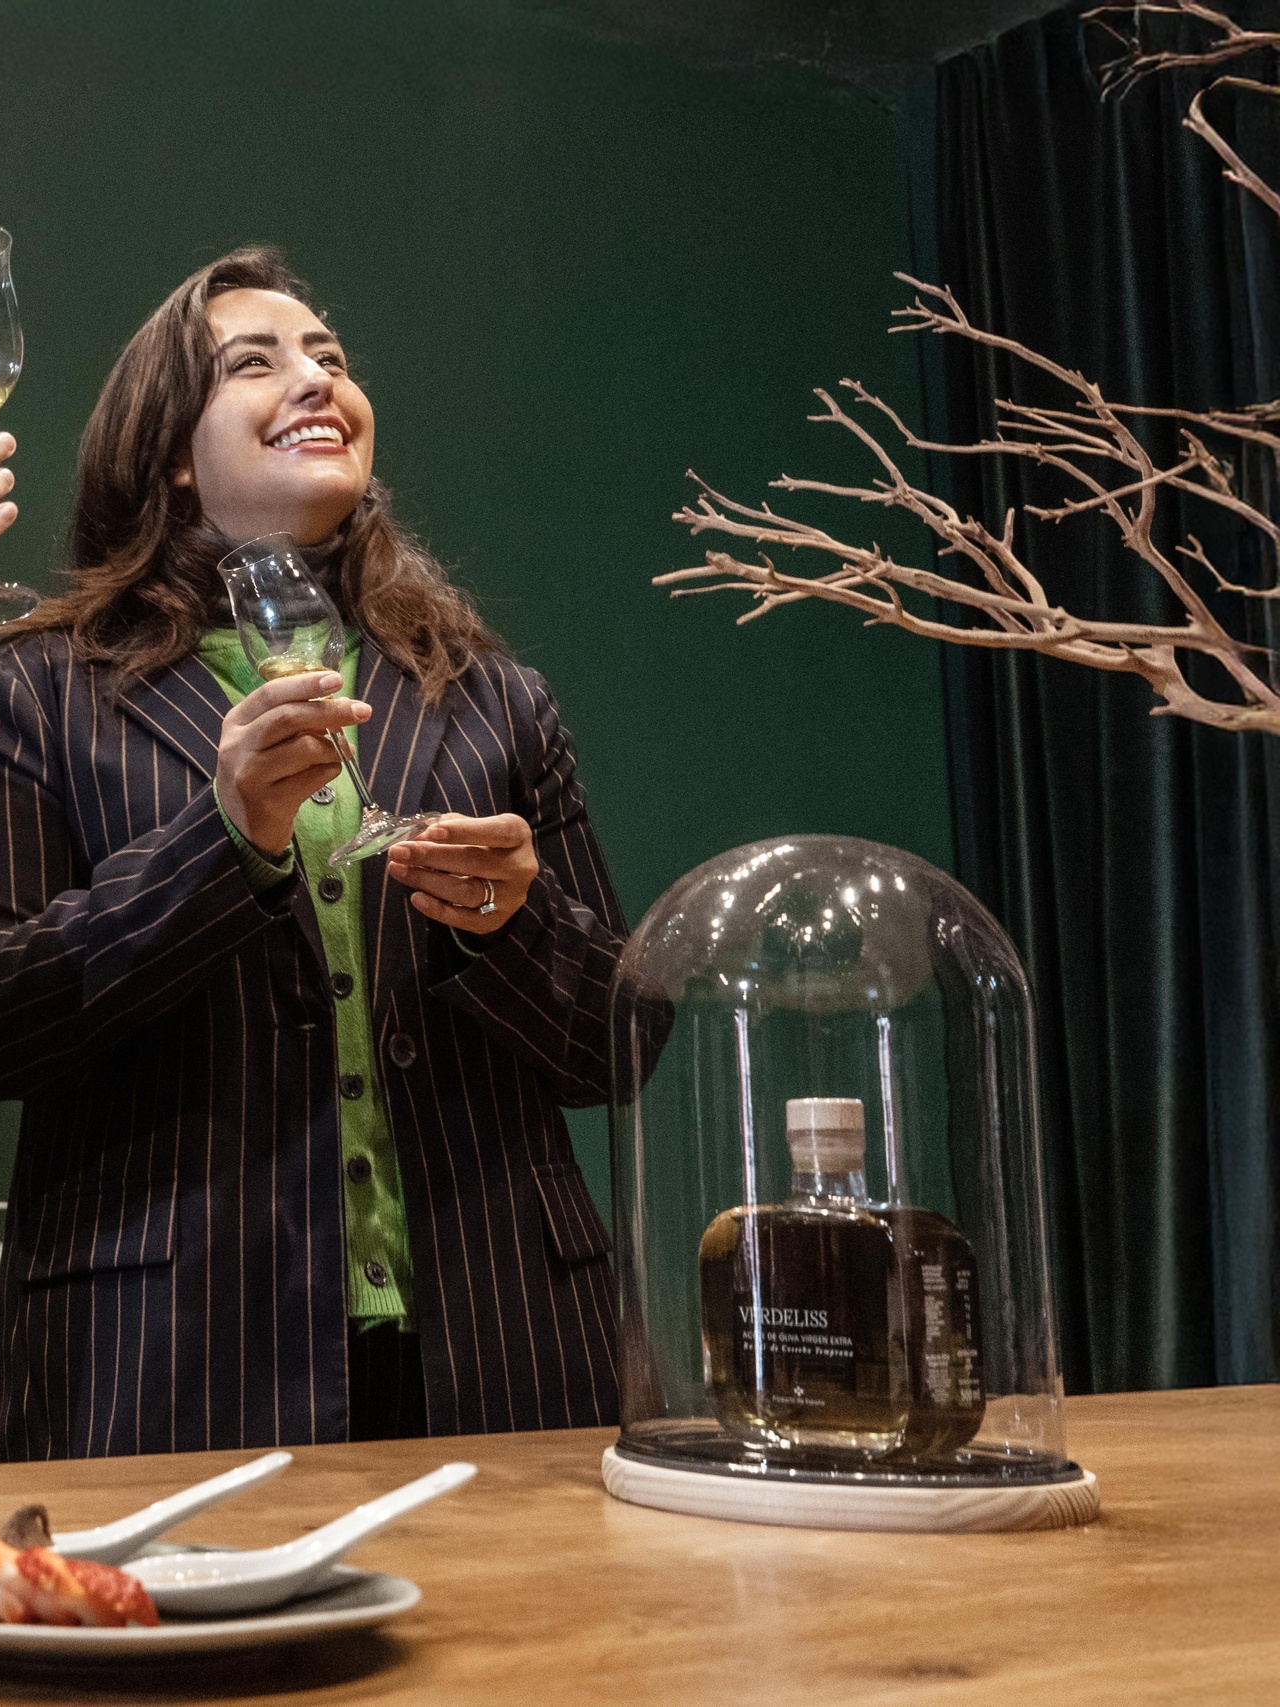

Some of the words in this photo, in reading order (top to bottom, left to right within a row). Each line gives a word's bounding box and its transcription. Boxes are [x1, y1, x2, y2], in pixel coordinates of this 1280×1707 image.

[778, 1332, 800, 1343] OLIVA
[800, 1334, 829, 1345] VIRGEN
[830, 1336, 853, 1347] EXTRA
